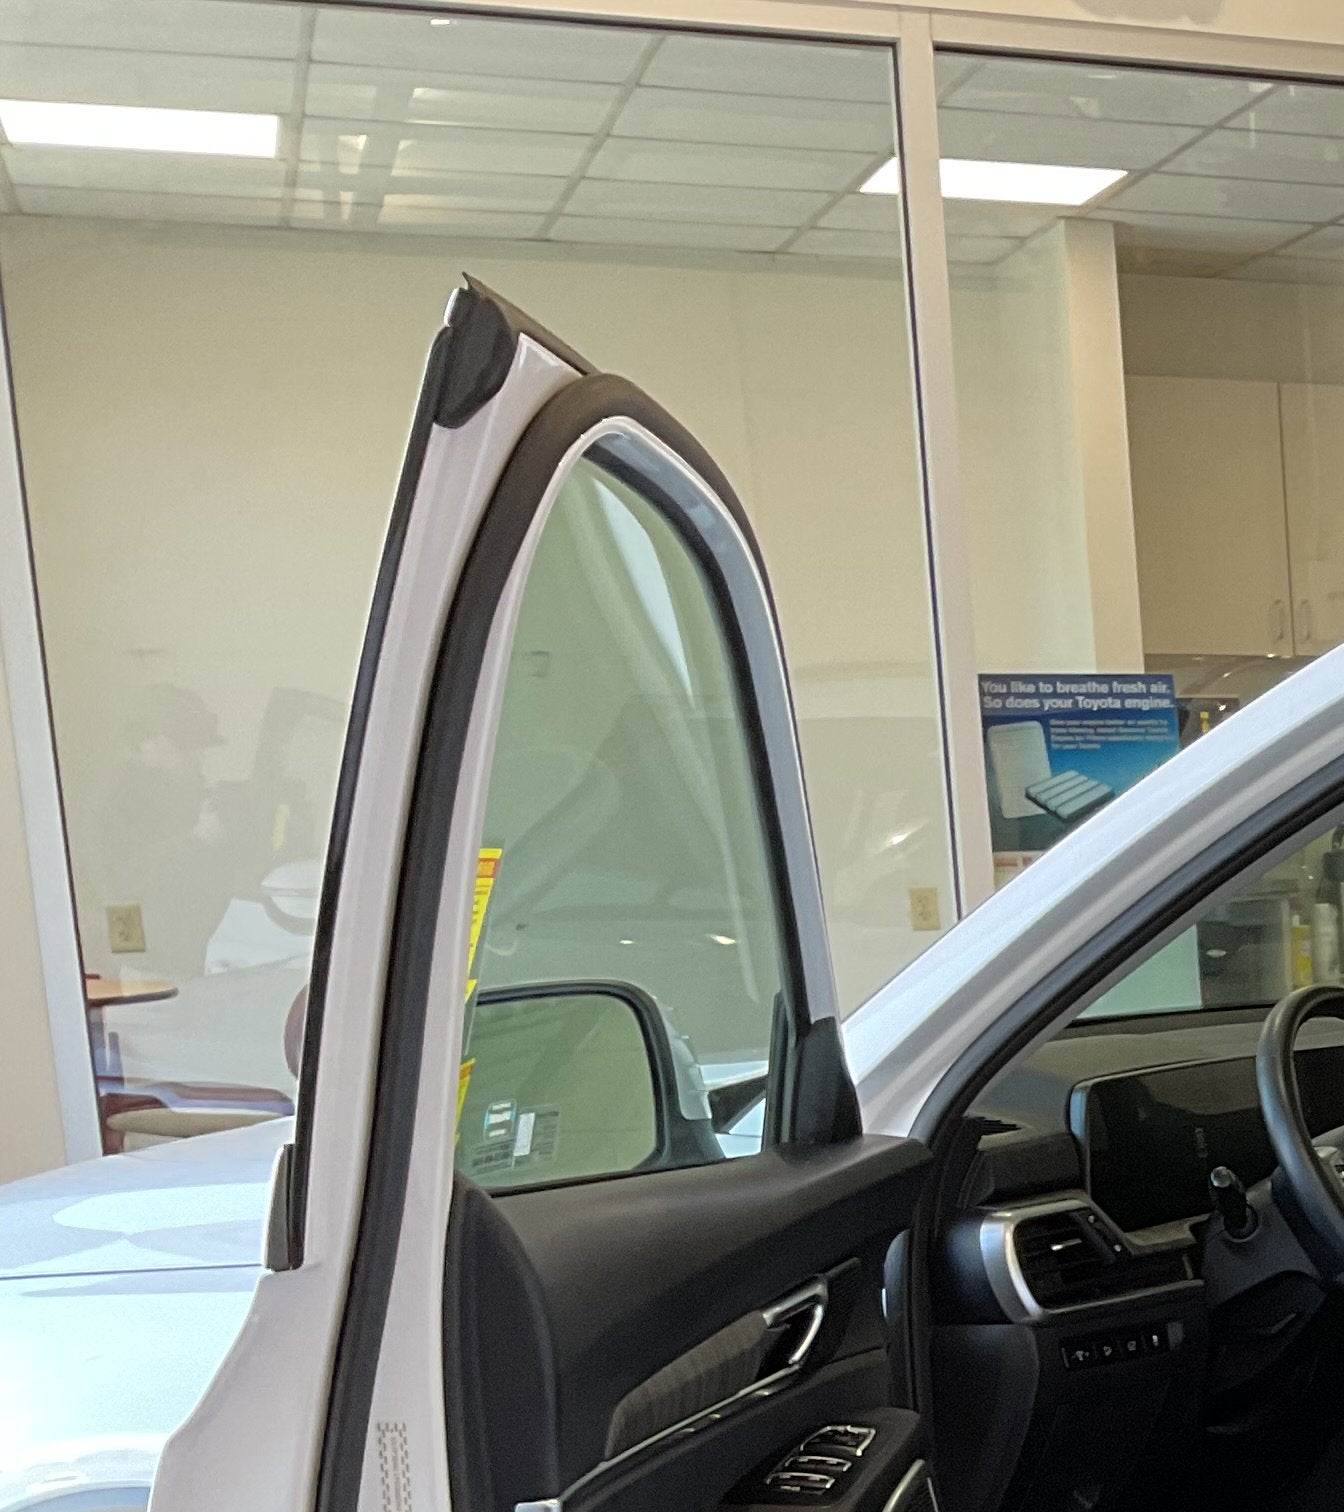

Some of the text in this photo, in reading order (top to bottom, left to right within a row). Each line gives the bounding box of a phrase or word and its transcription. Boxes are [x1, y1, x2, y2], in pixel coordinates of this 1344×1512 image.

[981, 680, 1171, 694] You like to breathe fresh air.
[983, 695, 1175, 711] So does your Toyota engine.
